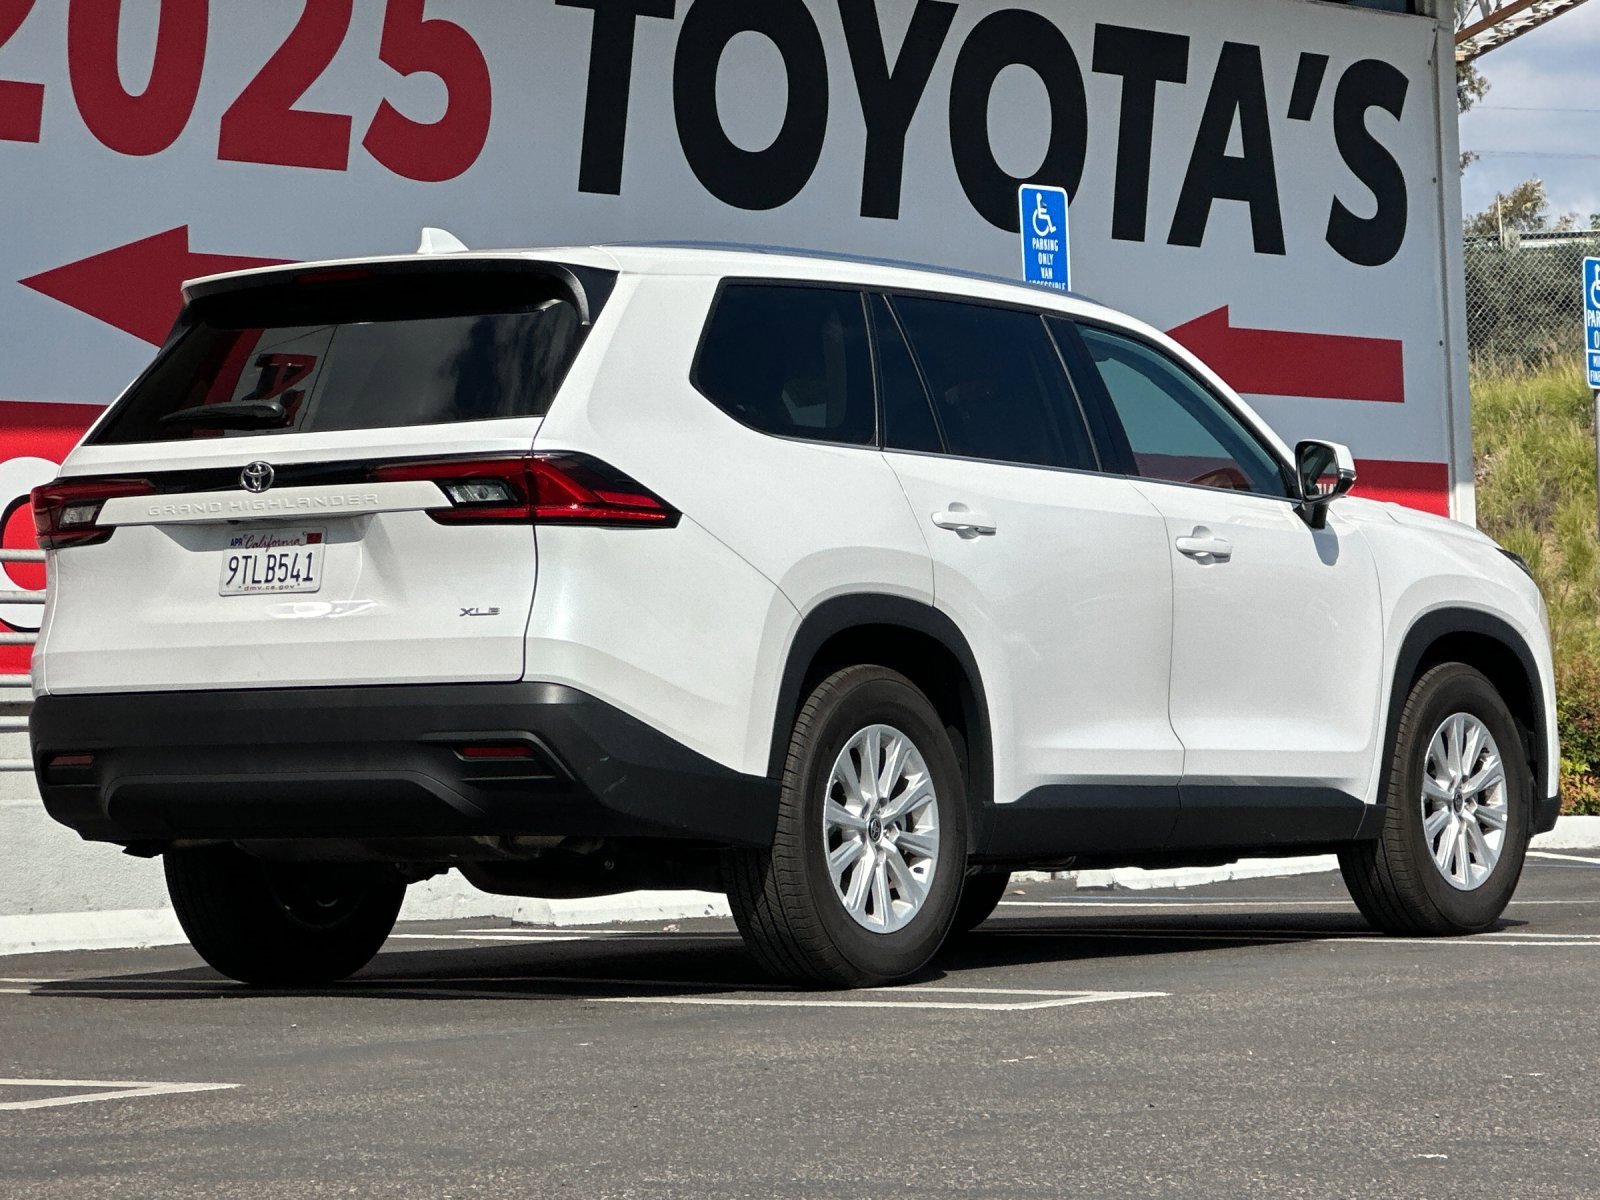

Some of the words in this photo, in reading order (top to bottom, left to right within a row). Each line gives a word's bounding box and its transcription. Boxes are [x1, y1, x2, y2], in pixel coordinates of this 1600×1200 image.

[555, 0, 1410, 267] TOYOTA'S
[1032, 237, 1059, 252] PARKING
[1037, 252, 1054, 265] ONLY
[1040, 266, 1053, 280] VAN
[148, 501, 222, 516] GRAND
[229, 493, 379, 512] HIGHLANDER
[230, 537, 243, 547] APR
[244, 533, 302, 552] California
[226, 551, 314, 586] 9TLB541
[244, 584, 295, 592] dmv.ca.gov
[459, 607, 501, 617] XLE
